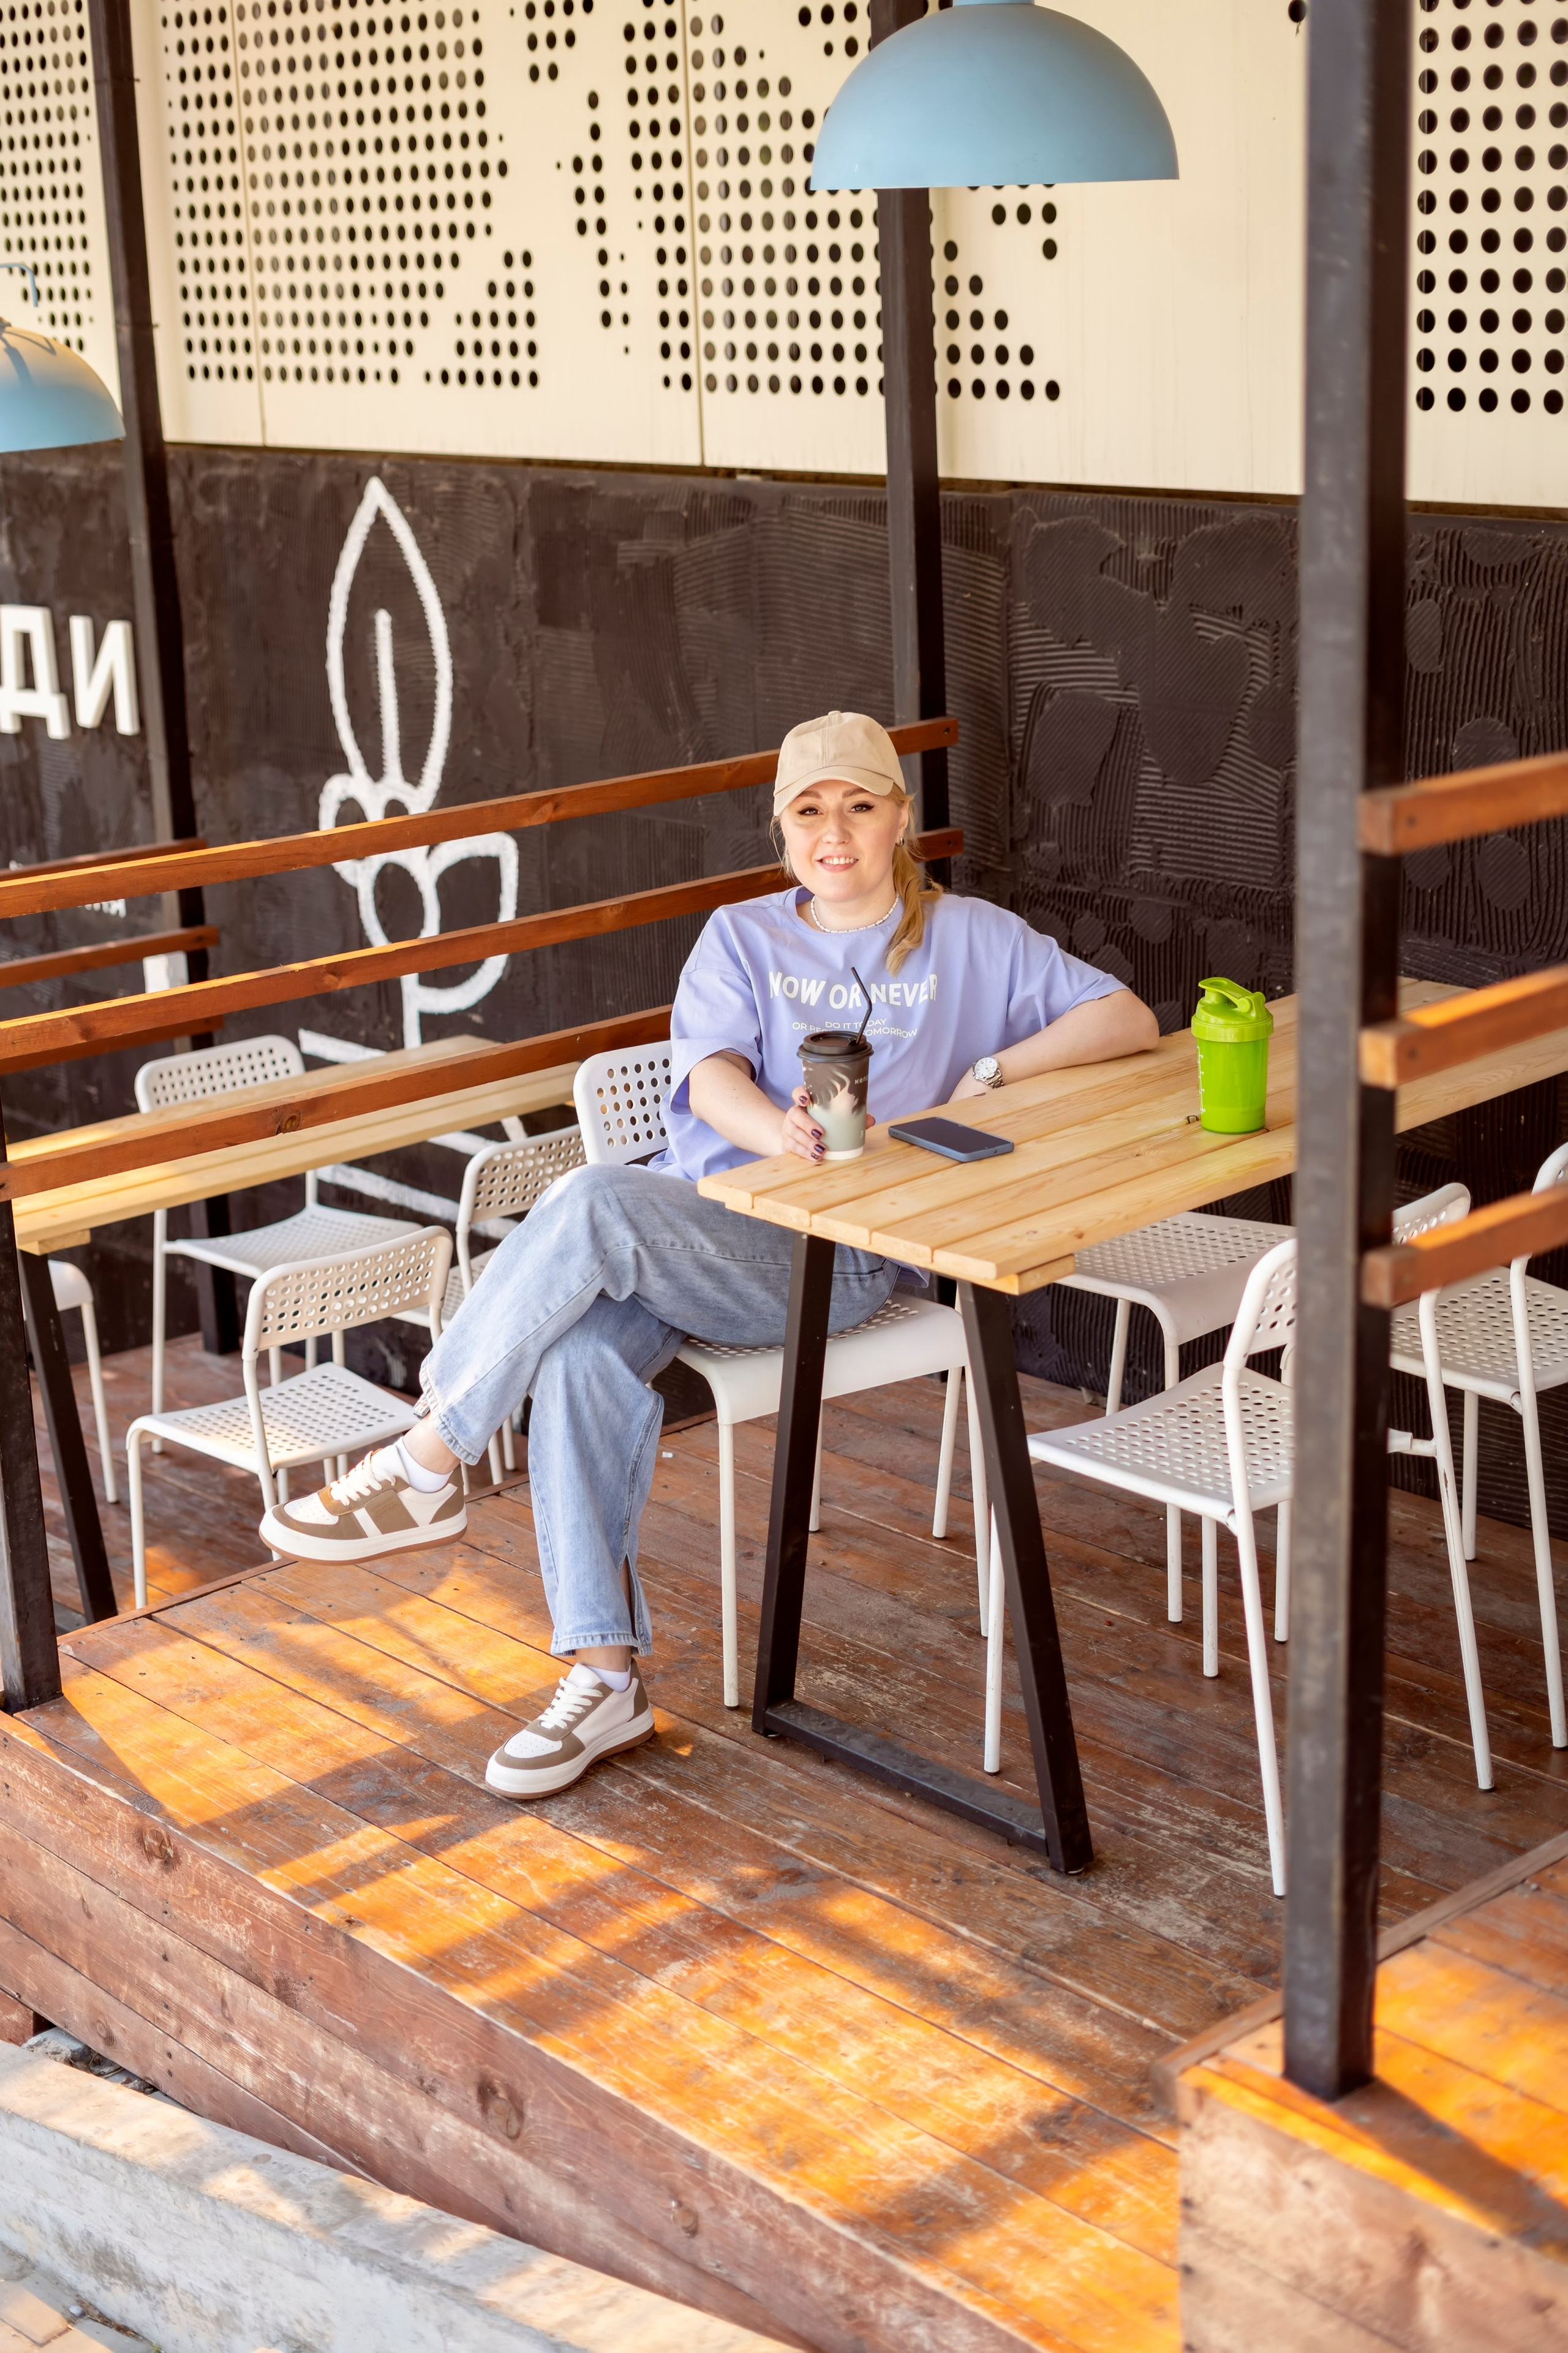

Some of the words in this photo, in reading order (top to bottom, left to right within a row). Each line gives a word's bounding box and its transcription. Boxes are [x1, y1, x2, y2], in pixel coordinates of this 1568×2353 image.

[769, 971, 826, 1007] NOW
[829, 983, 862, 1010] OR
[870, 973, 938, 1007] NEVER
[792, 1022, 807, 1030] OR
[864, 1027, 918, 1038] OMORROW
